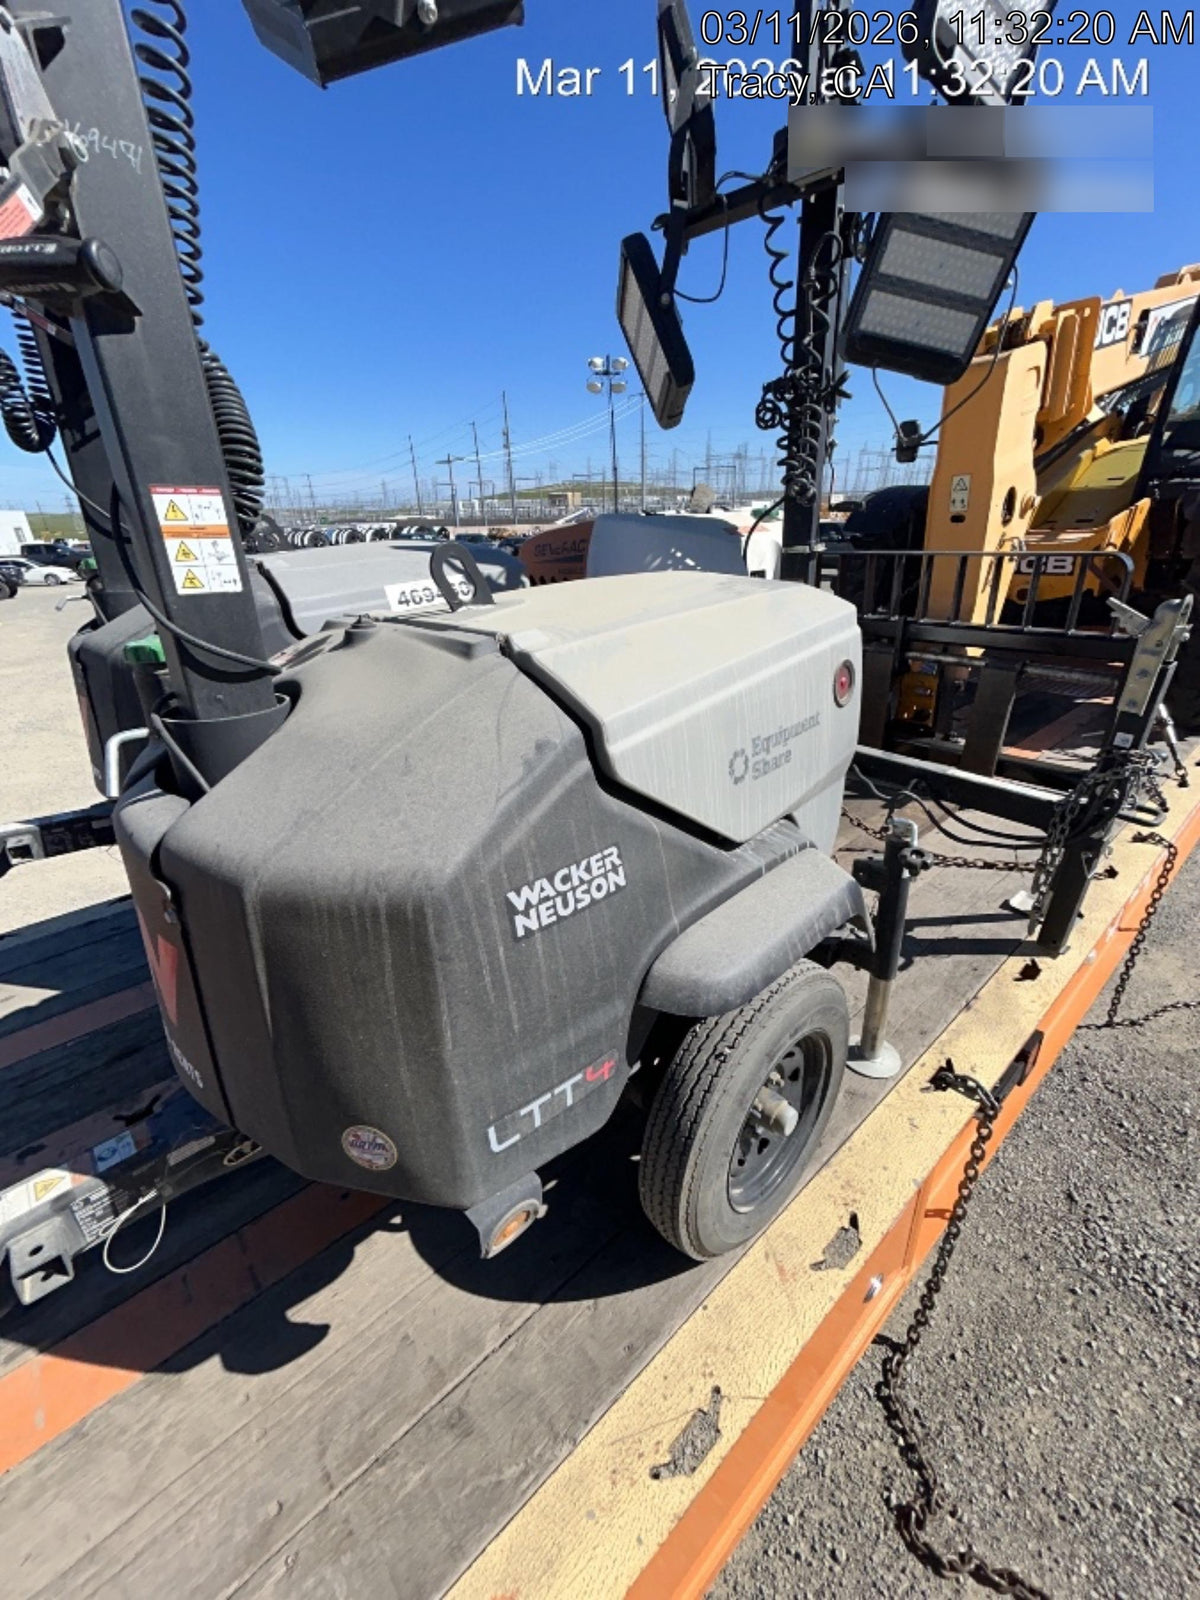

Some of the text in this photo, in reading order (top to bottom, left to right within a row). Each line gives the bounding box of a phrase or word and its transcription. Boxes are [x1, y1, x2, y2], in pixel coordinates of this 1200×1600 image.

[752, 712, 821, 757] Equipment
[752, 750, 792, 781] Share
[506, 846, 622, 911] WACKER
[514, 866, 626, 937] NEUSON
